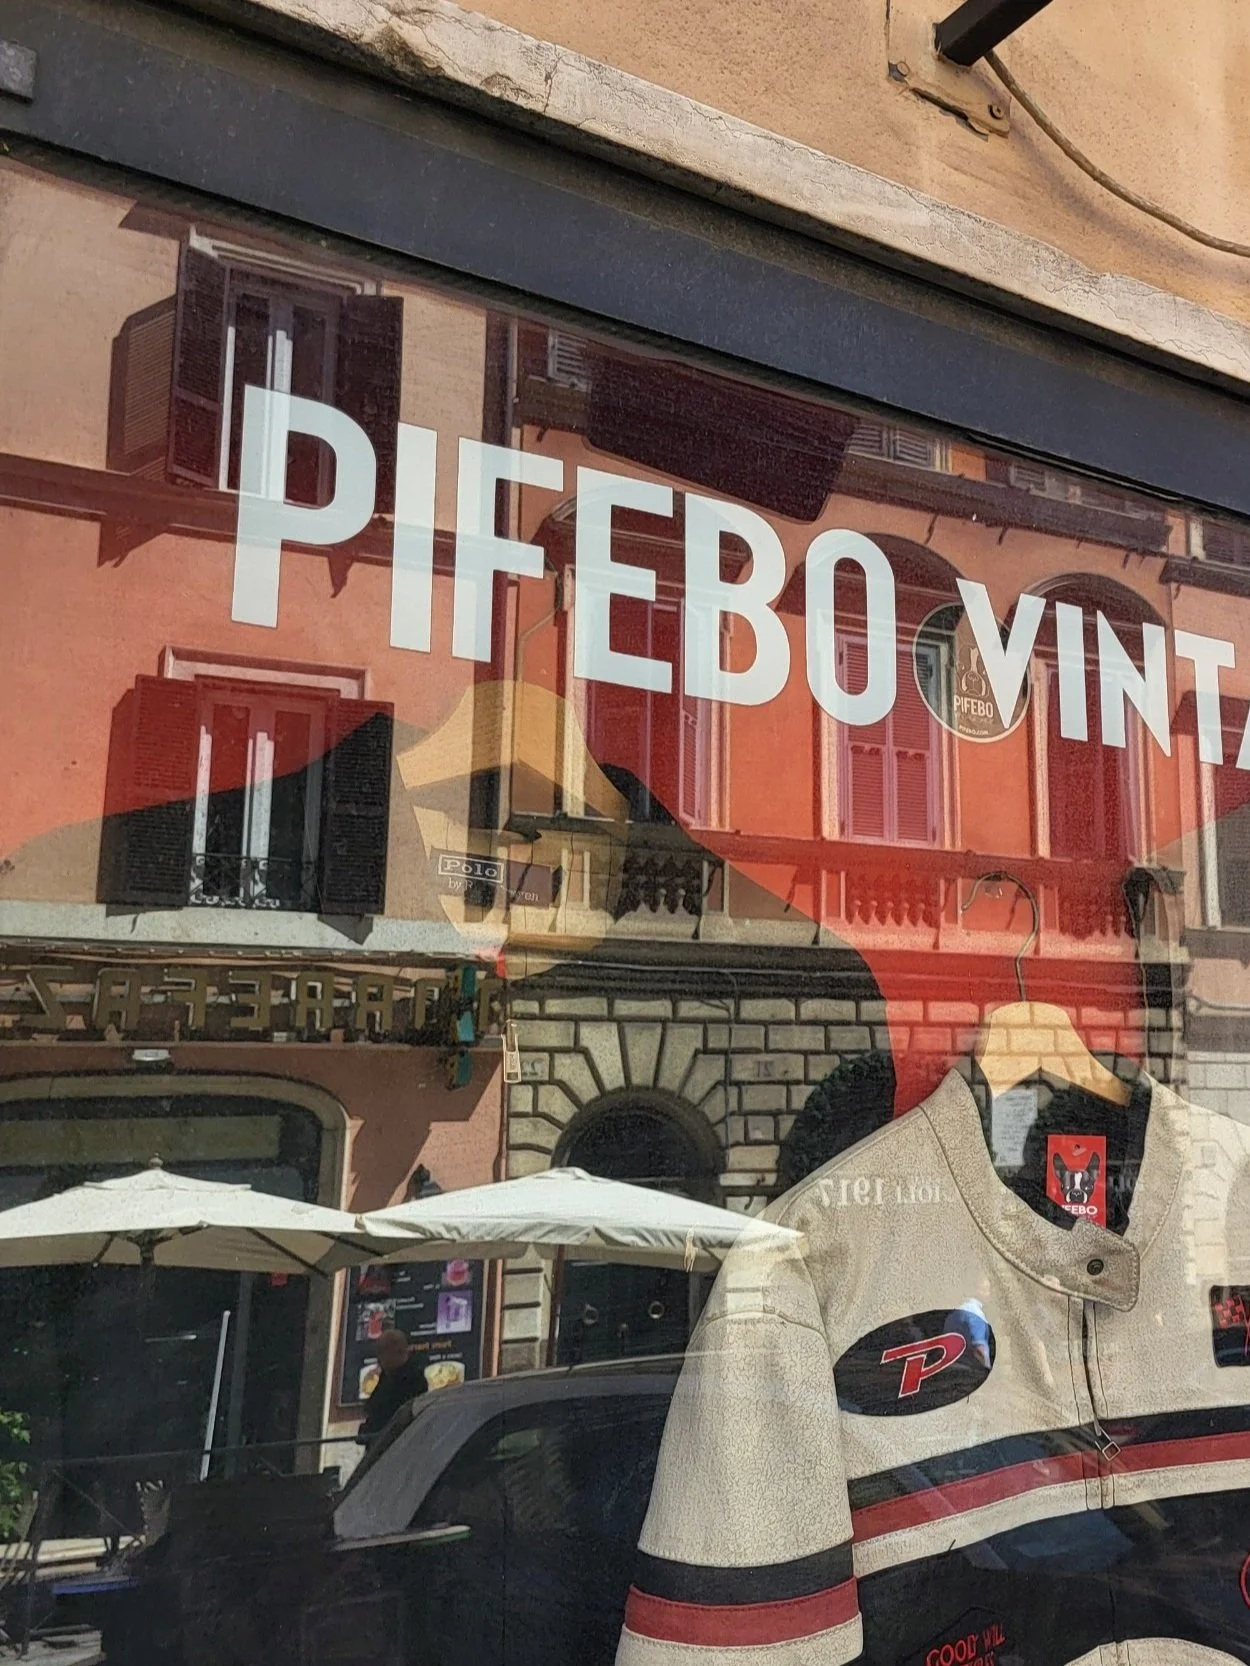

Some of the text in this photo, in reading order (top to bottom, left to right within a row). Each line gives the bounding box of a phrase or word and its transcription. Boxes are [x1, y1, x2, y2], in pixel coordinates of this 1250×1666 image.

[232, 385, 898, 726] PIFEBO
[953, 695, 994, 718] PIFEBO
[443, 857, 498, 878] Polo
